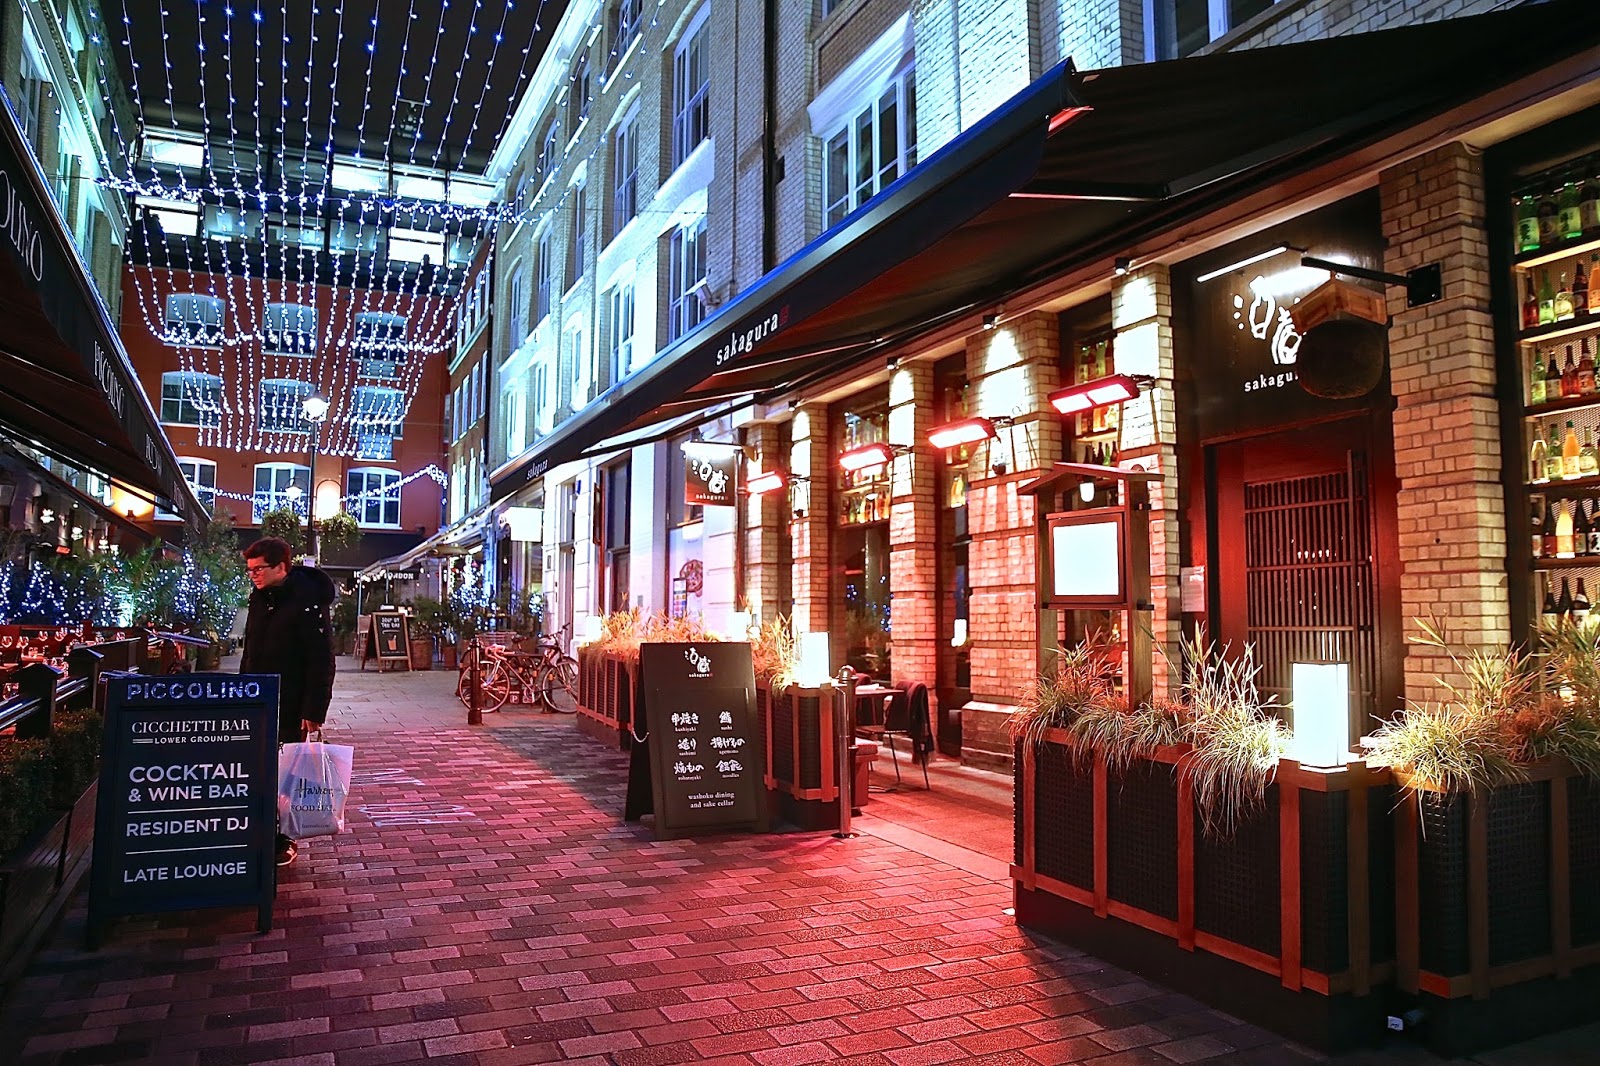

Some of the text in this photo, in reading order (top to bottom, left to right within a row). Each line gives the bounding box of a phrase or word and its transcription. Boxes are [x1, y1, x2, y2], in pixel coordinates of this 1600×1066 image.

[717, 313, 779, 365] sakagura
[127, 681, 261, 700] PICCOLINO
[131, 719, 250, 734] CICCHETTI BAR
[154, 735, 230, 744] LOWER GROUND
[129, 763, 249, 783] COCKTAIL
[128, 783, 249, 803] & WINE BAR
[687, 791, 735, 800] washoku dining
[703, 800, 716, 808] sake
[126, 816, 249, 837] RESIDENT DJ
[123, 861, 247, 883] LATE LOUNGE
